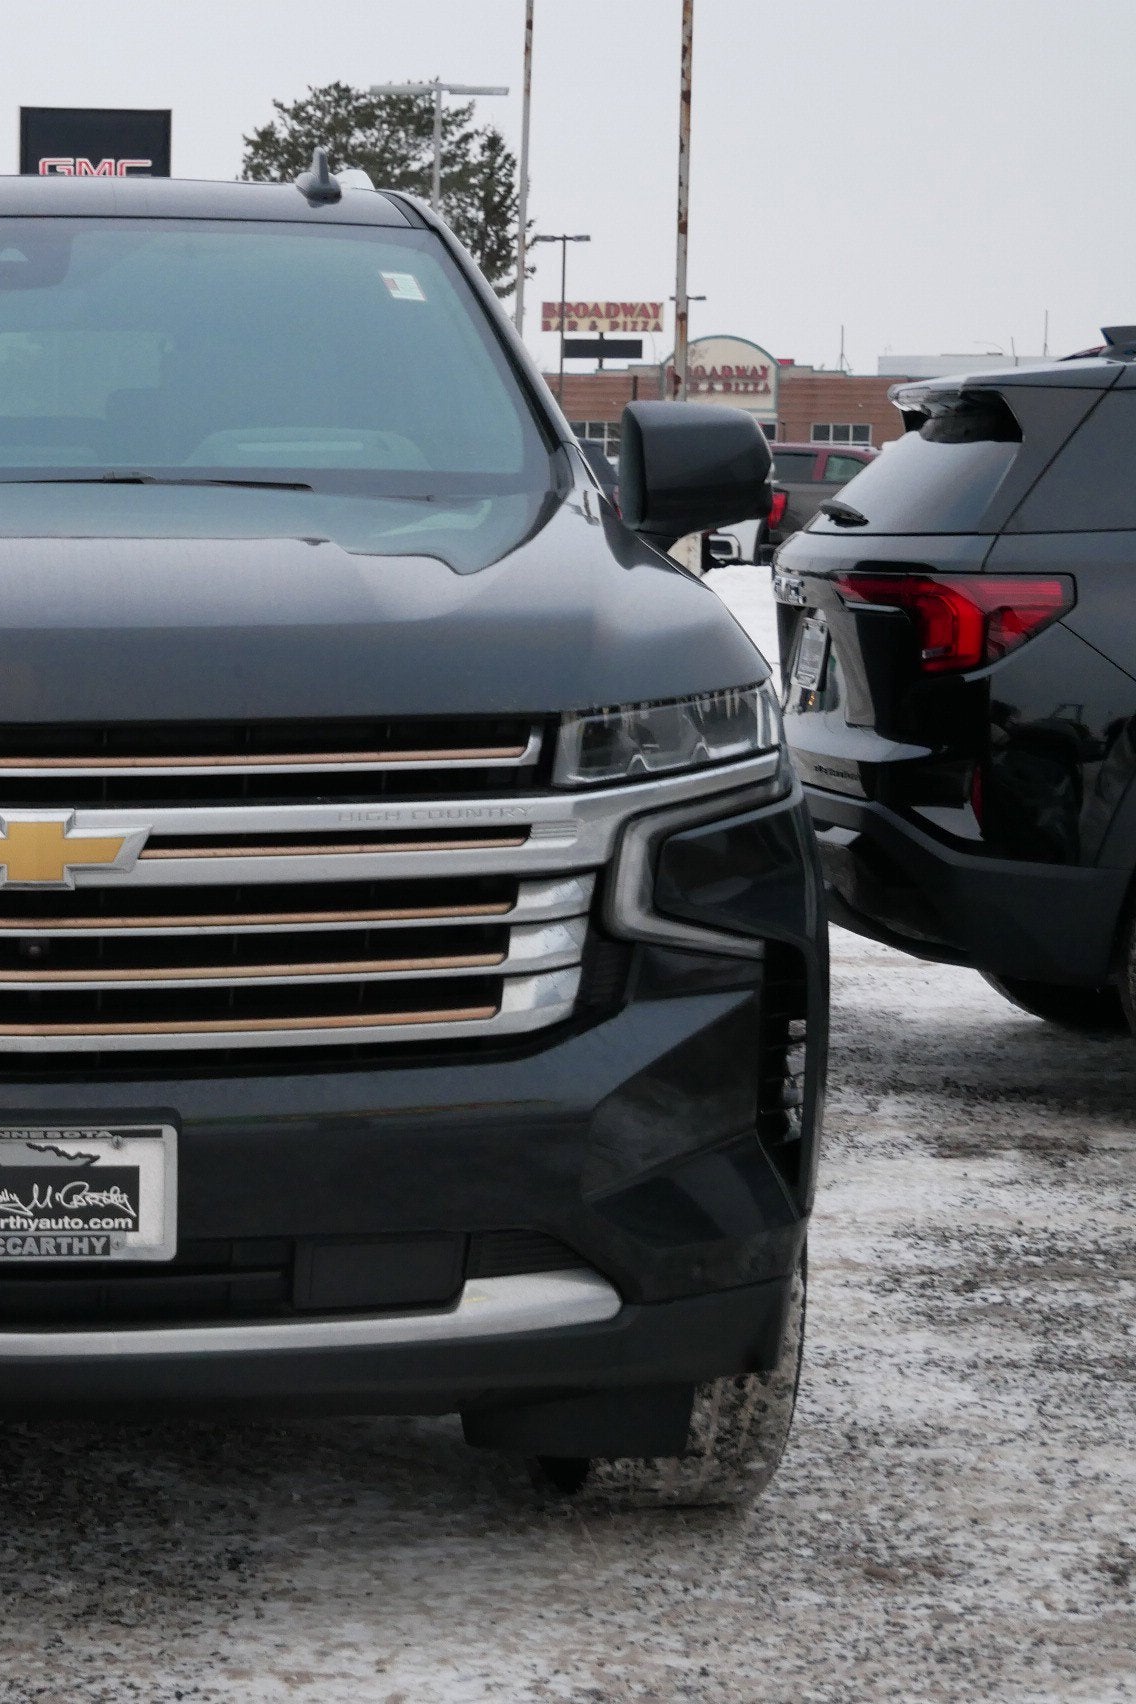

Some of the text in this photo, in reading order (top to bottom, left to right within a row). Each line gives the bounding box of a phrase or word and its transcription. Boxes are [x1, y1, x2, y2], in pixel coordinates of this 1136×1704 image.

[38, 157, 153, 177] GMC
[542, 302, 662, 319] BROADWAY
[542, 320, 662, 332] BAR & PIZZA
[723, 381, 771, 394] PIZZA
[338, 806, 531, 822] HIGH COUNTRY
